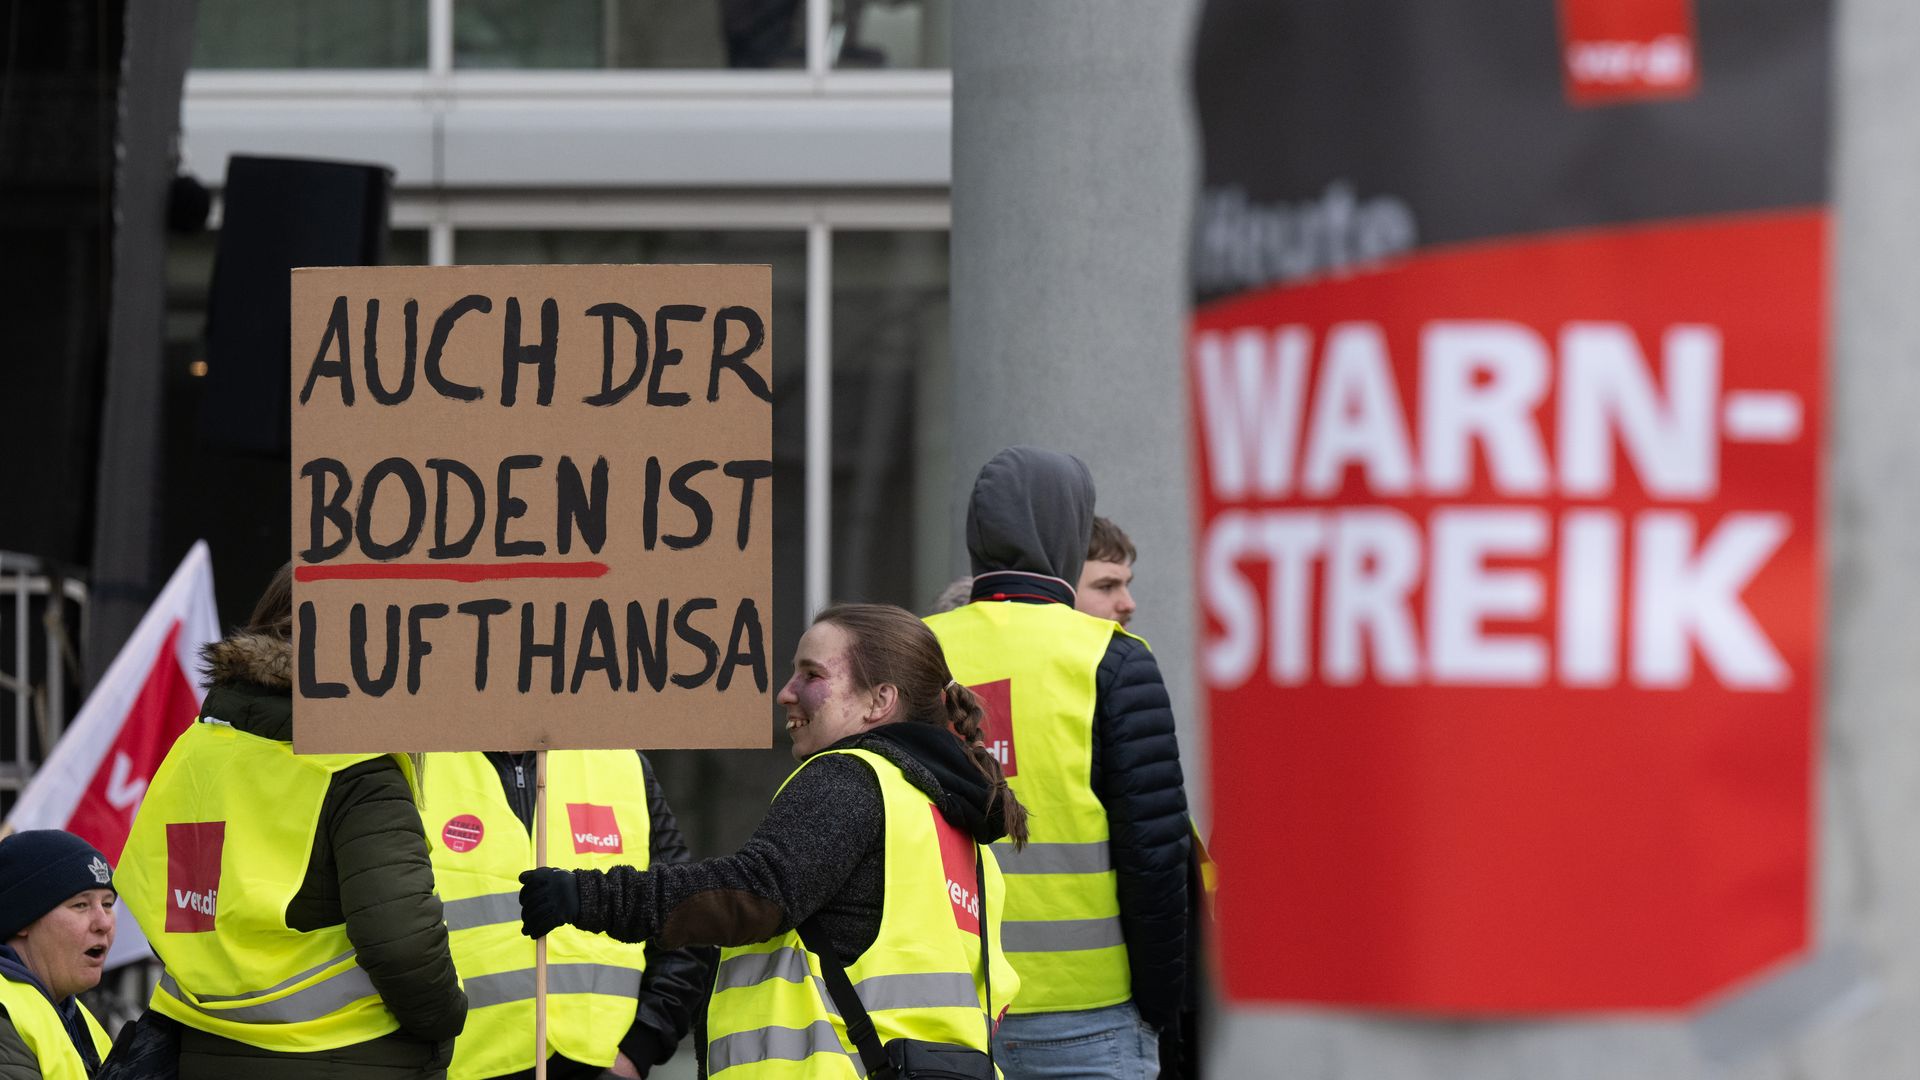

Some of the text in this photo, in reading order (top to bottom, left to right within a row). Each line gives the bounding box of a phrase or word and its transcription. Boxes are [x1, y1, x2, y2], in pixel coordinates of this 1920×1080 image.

[299, 294, 773, 408] AUCH DER
[1195, 319, 1802, 500] WARN-
[299, 454, 773, 564] BODEN IST
[299, 597, 769, 699] LUFTHANSA
[1201, 505, 1794, 691] STREIK
[574, 832, 619, 848] ver.di
[174, 888, 217, 917] ver.di
